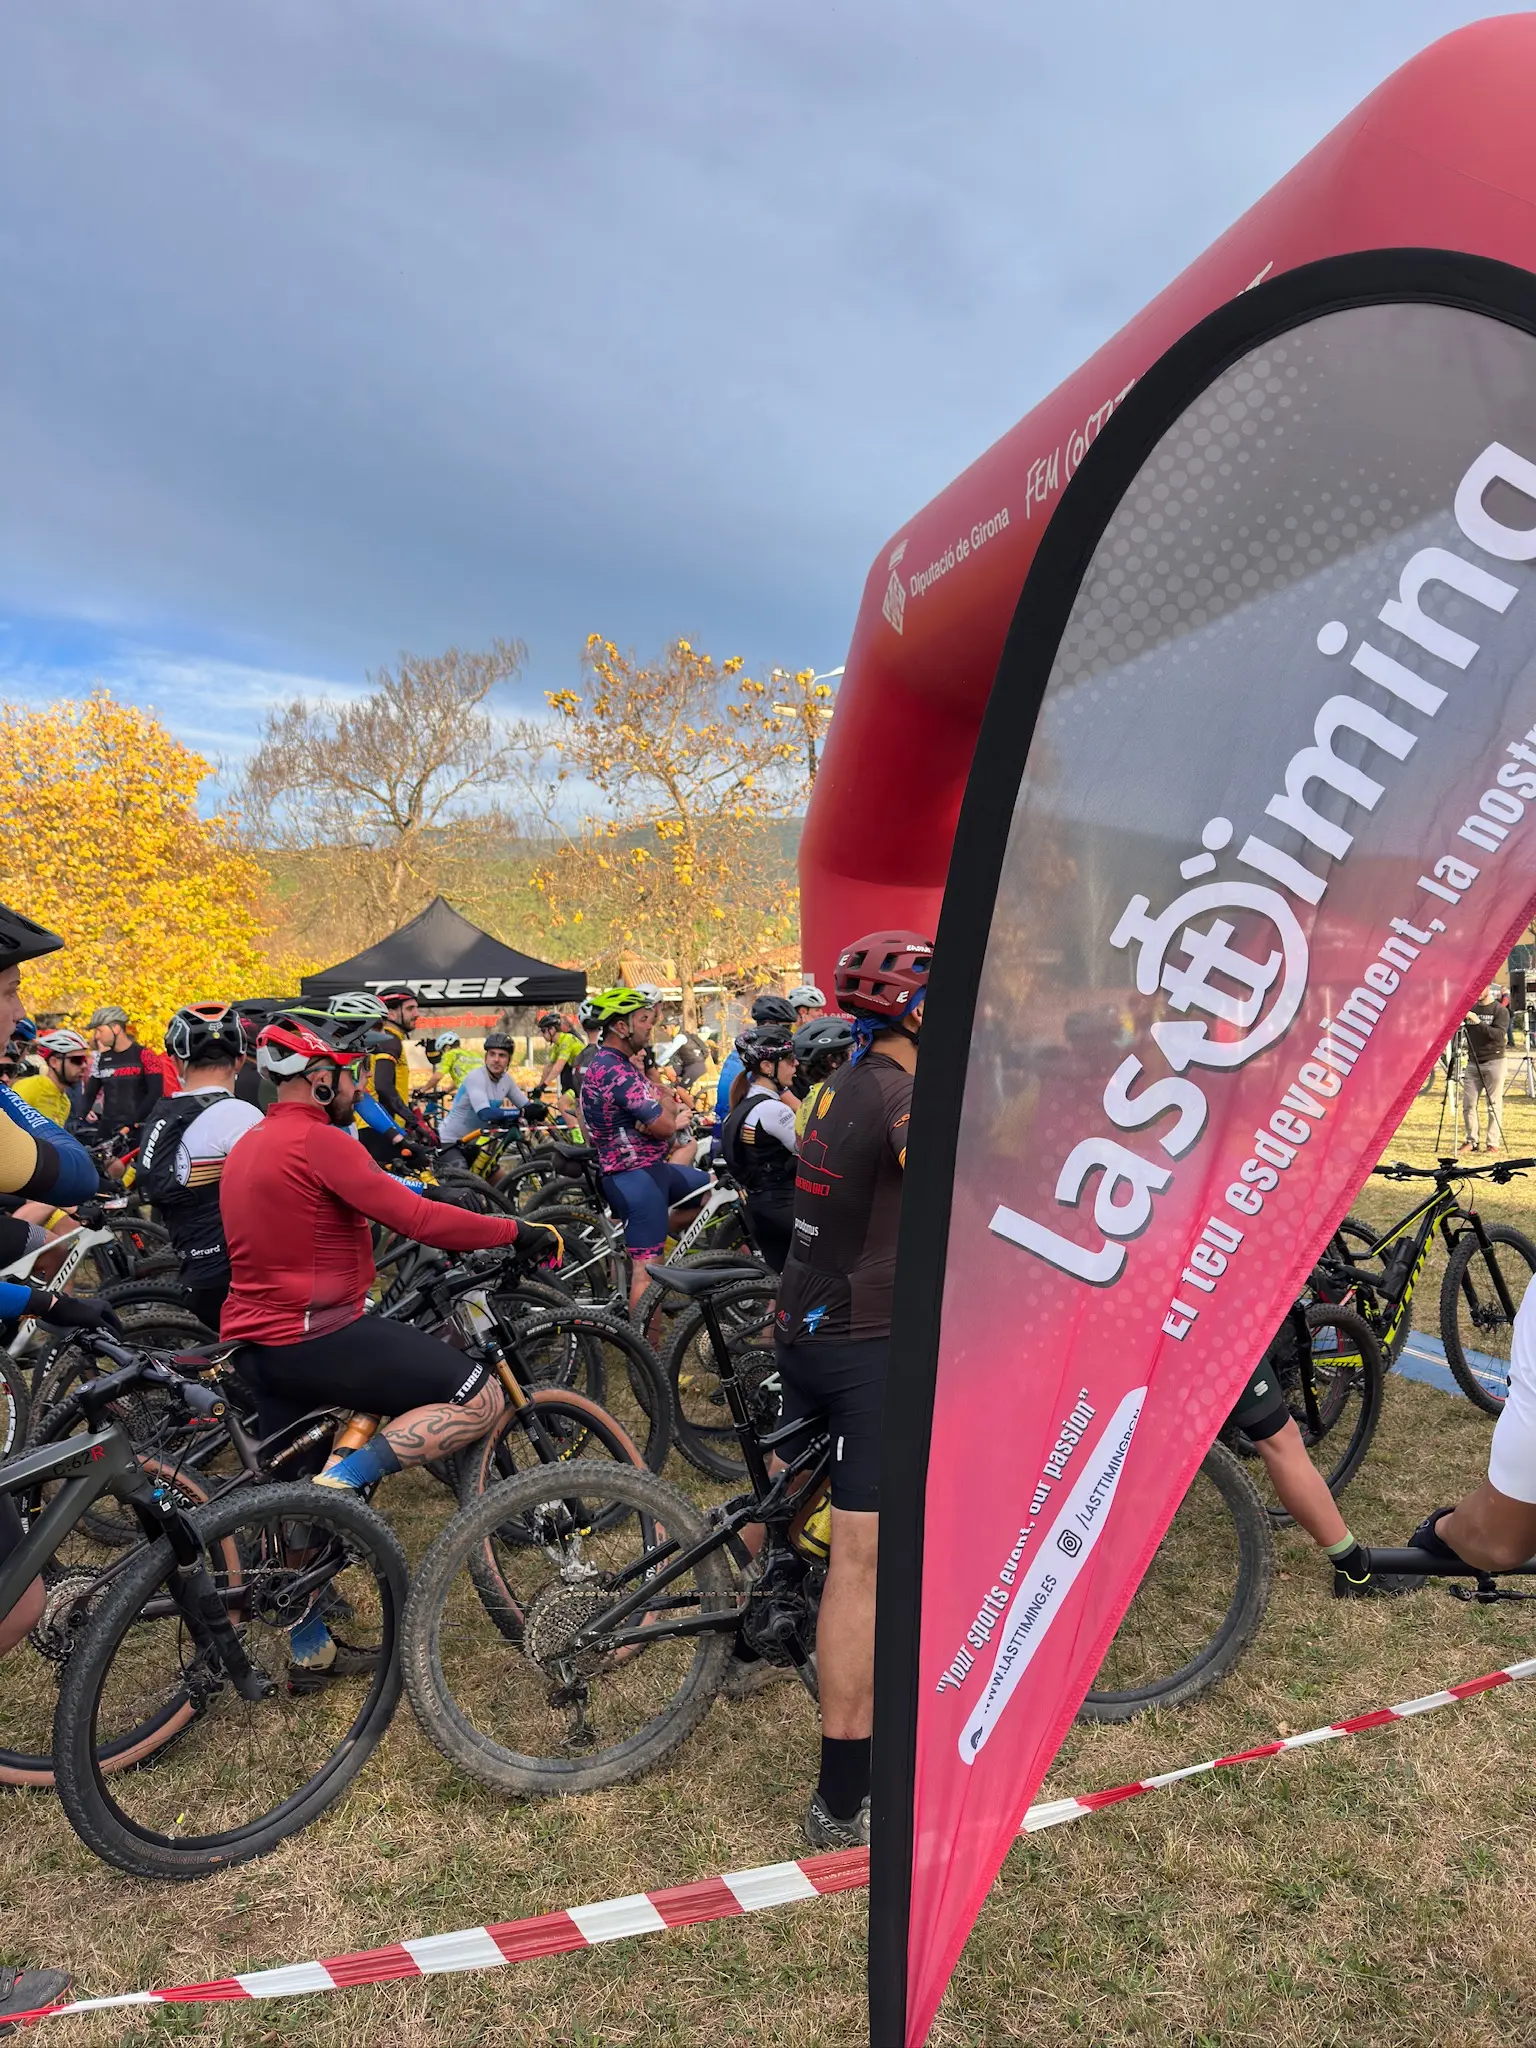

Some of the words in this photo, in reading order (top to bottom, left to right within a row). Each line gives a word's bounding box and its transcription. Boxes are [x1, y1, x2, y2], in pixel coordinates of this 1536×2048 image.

[1025, 447, 1059, 520] FEM
[910, 544, 955, 598] Diputació
[956, 538, 970, 563] de
[970, 507, 1009, 551] Girona
[364, 976, 530, 1000] TREK
[414, 1010, 505, 1029] owerbar
[1181, 1216, 1244, 1293] teu
[1225, 917, 1446, 1216] esdeveniment,
[1417, 855, 1480, 905] la
[190, 1244, 221, 1258] Gerard
[667, 1209, 710, 1266] egamo
[967, 1585, 1010, 1652] sports
[1029, 1480, 1053, 1516] our
[983, 1574, 1057, 1714] WW.LASTTIMING.ES
